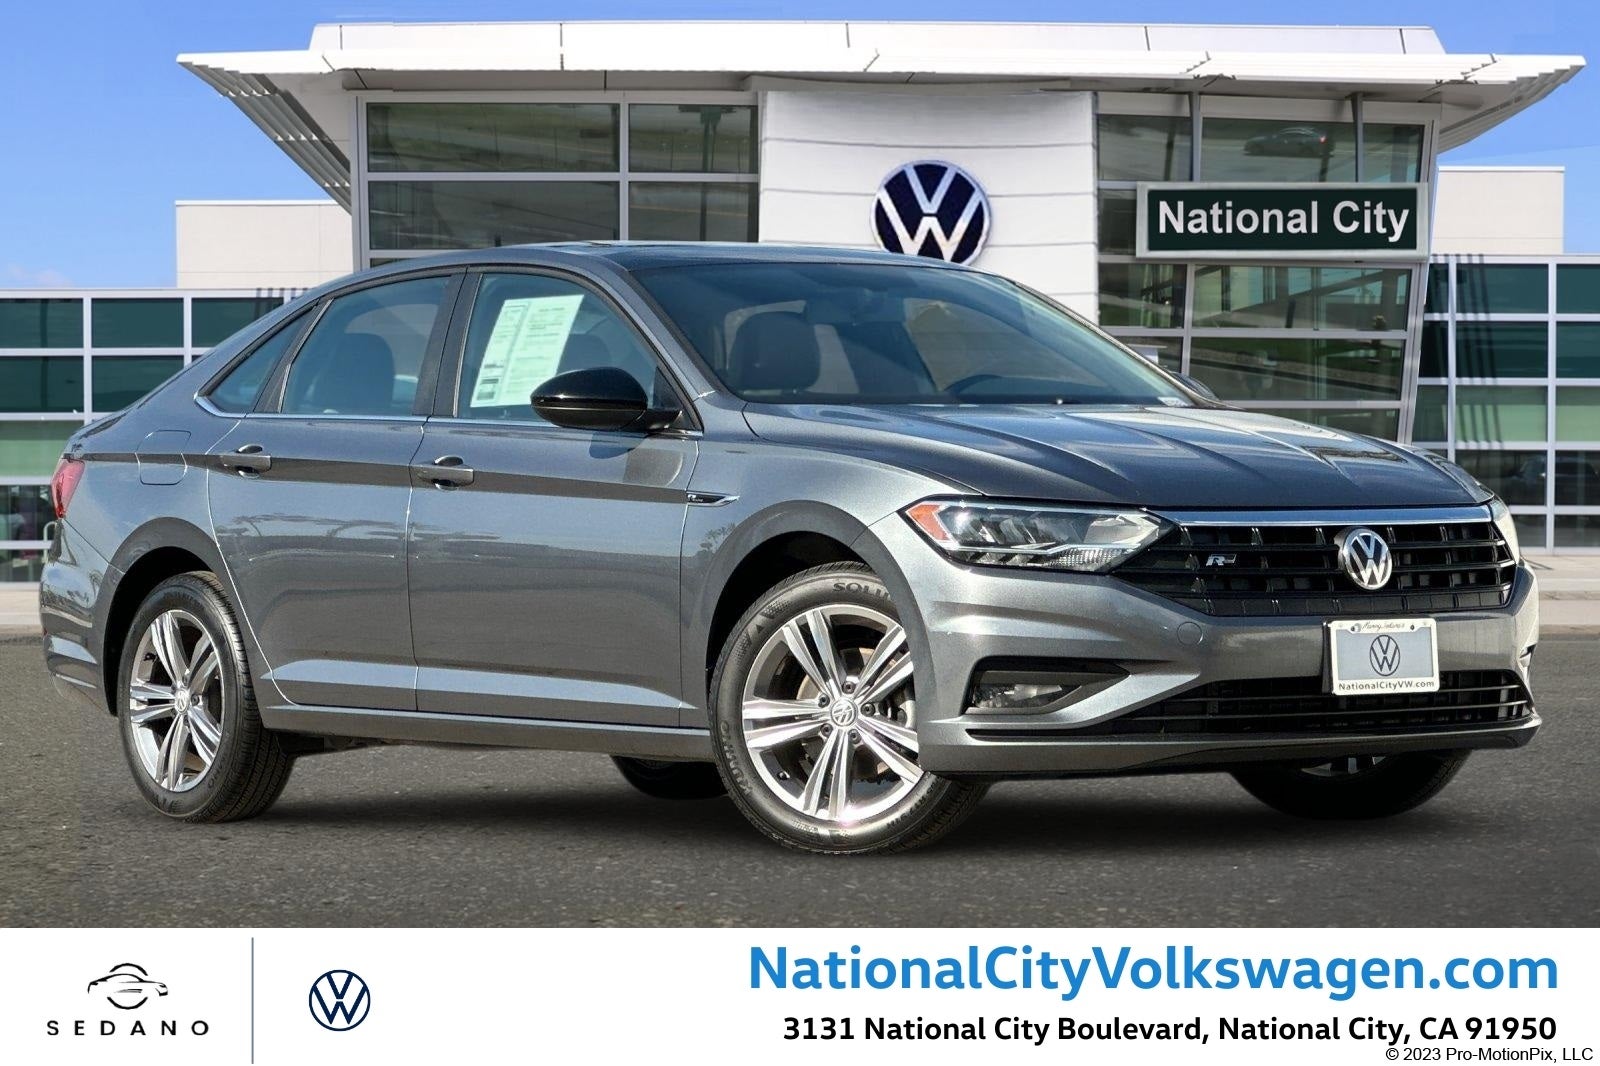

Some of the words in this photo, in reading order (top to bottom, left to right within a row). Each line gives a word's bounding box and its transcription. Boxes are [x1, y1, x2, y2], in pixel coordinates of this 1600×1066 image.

[1158, 200, 1318, 234] National
[1333, 200, 1409, 243] City
[1338, 680, 1435, 691] NationalCityVW.com
